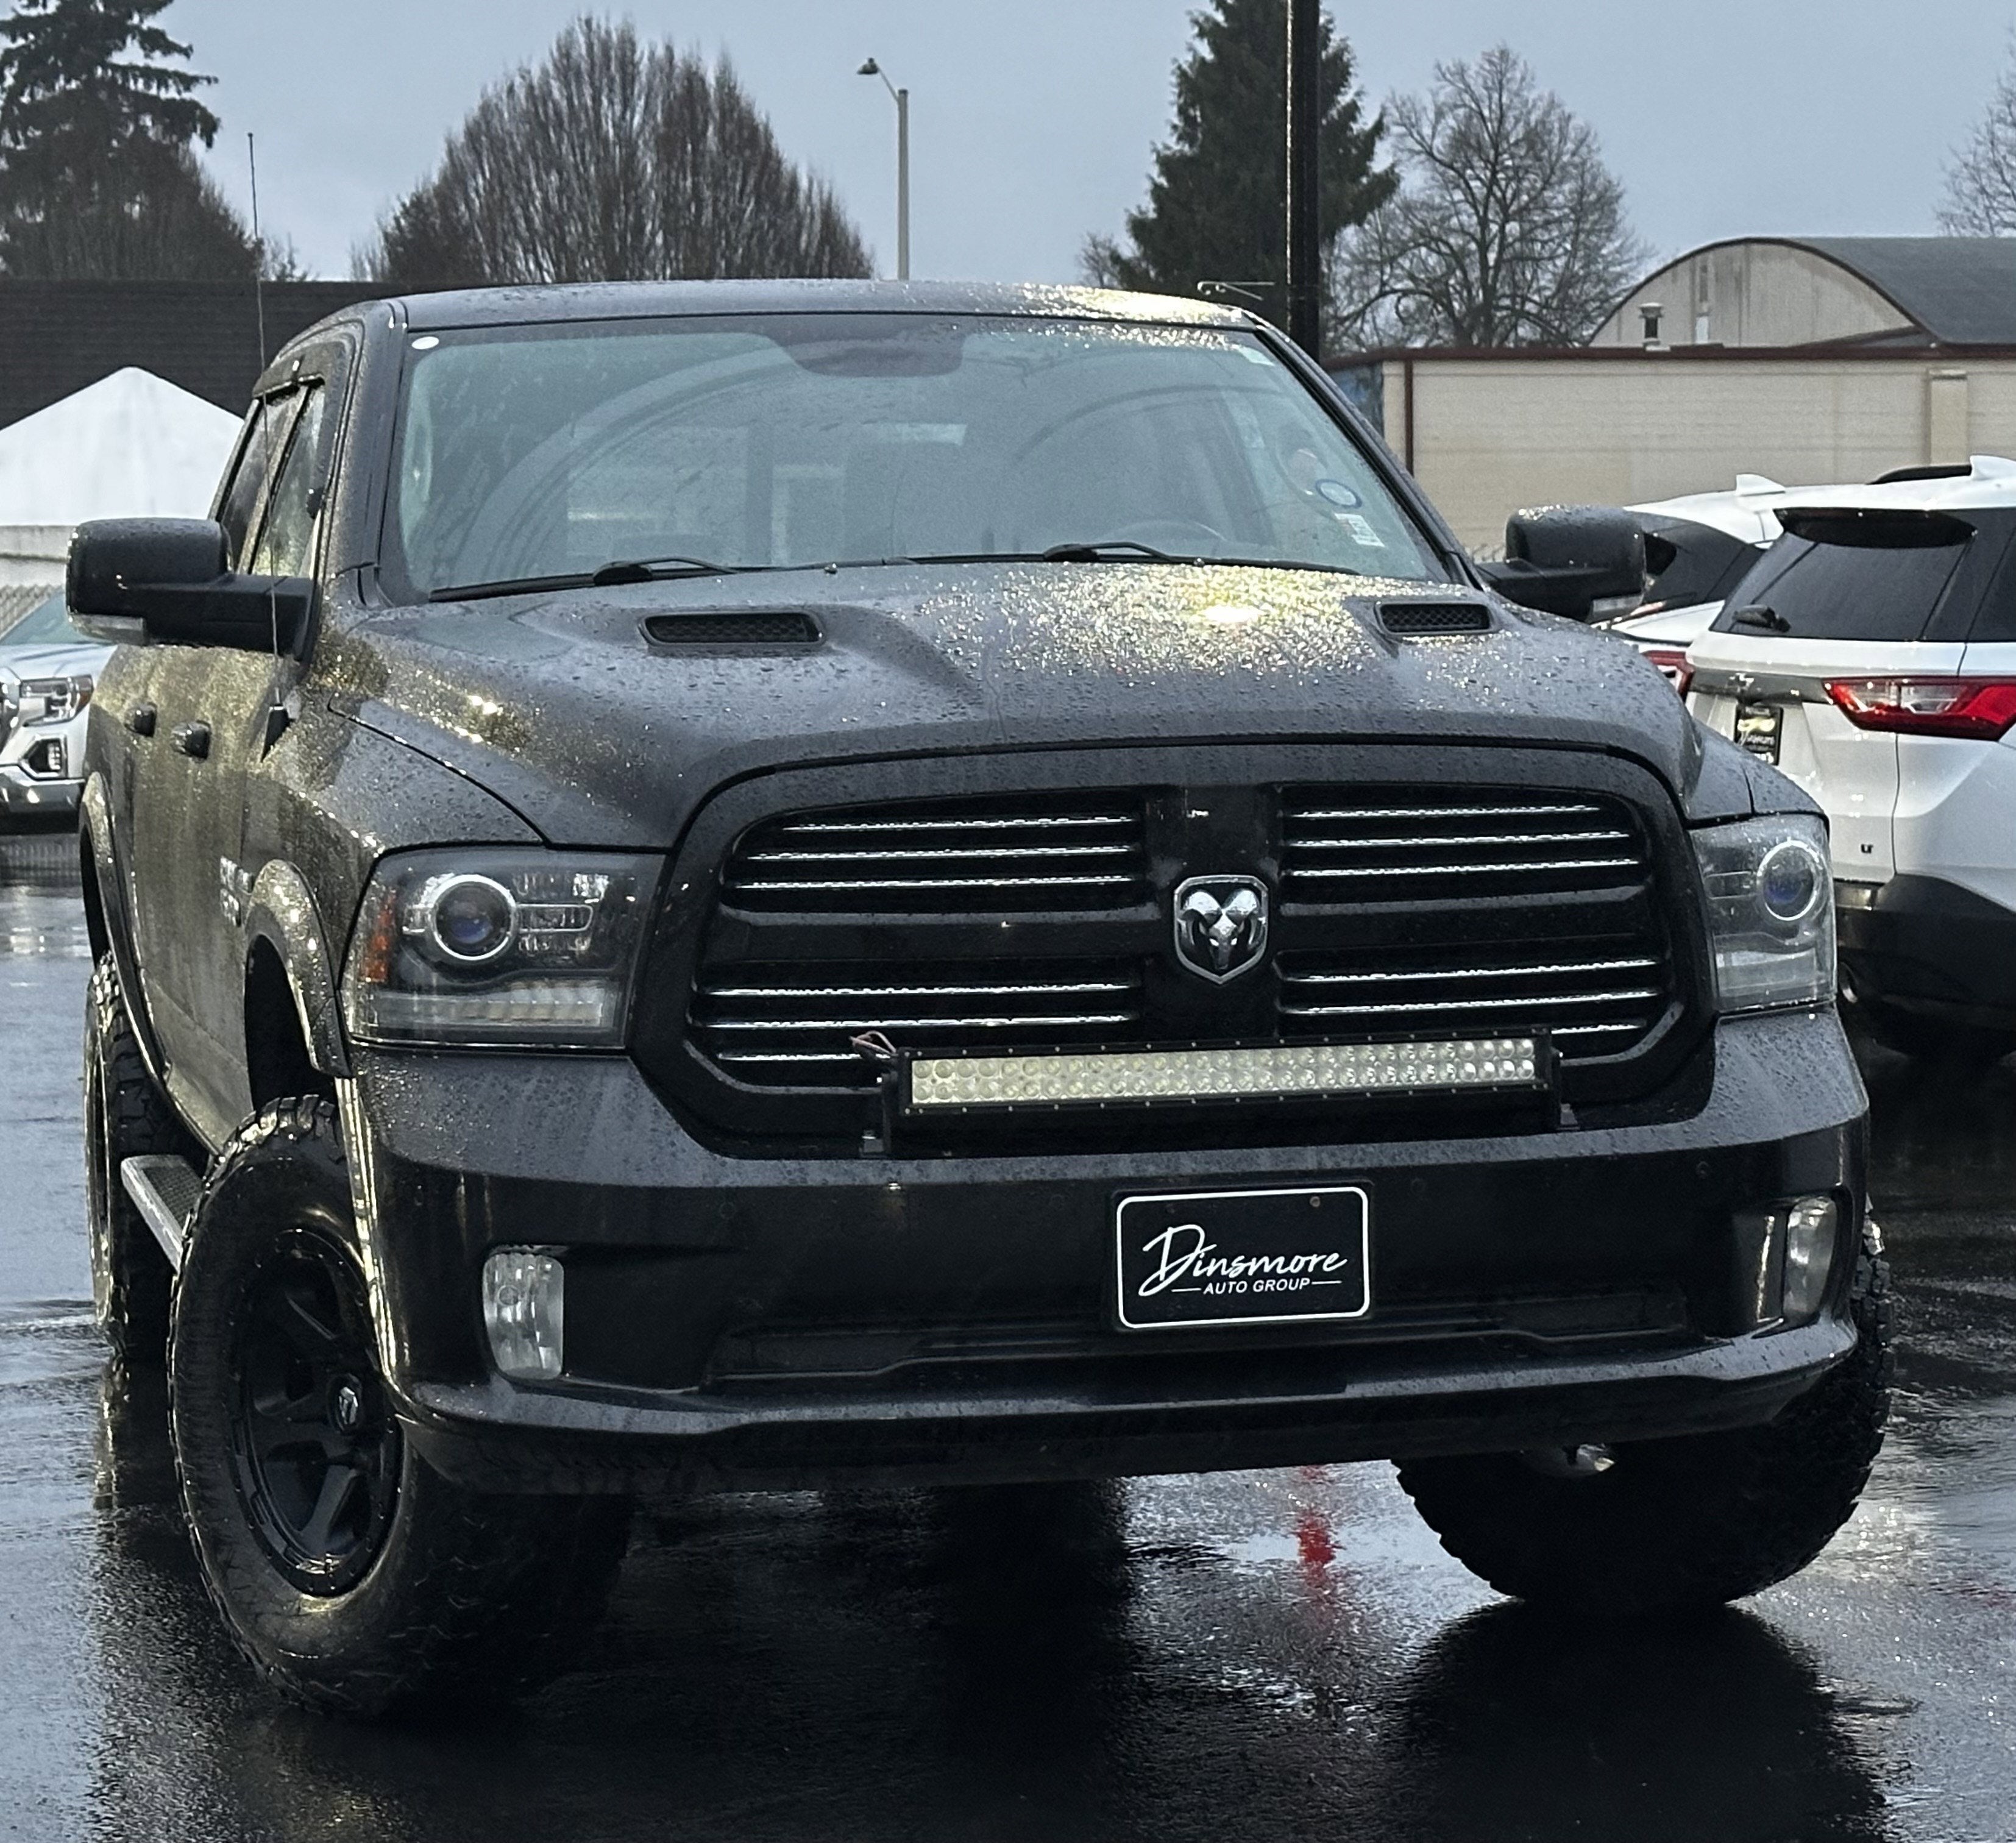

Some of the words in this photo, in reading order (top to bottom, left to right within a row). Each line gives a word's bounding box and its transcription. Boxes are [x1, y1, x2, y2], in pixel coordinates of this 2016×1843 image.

[1138, 1224, 1347, 1296] Dinsmore
[1203, 1280, 1248, 1294] AUTO
[1253, 1278, 1310, 1292] GROUP
